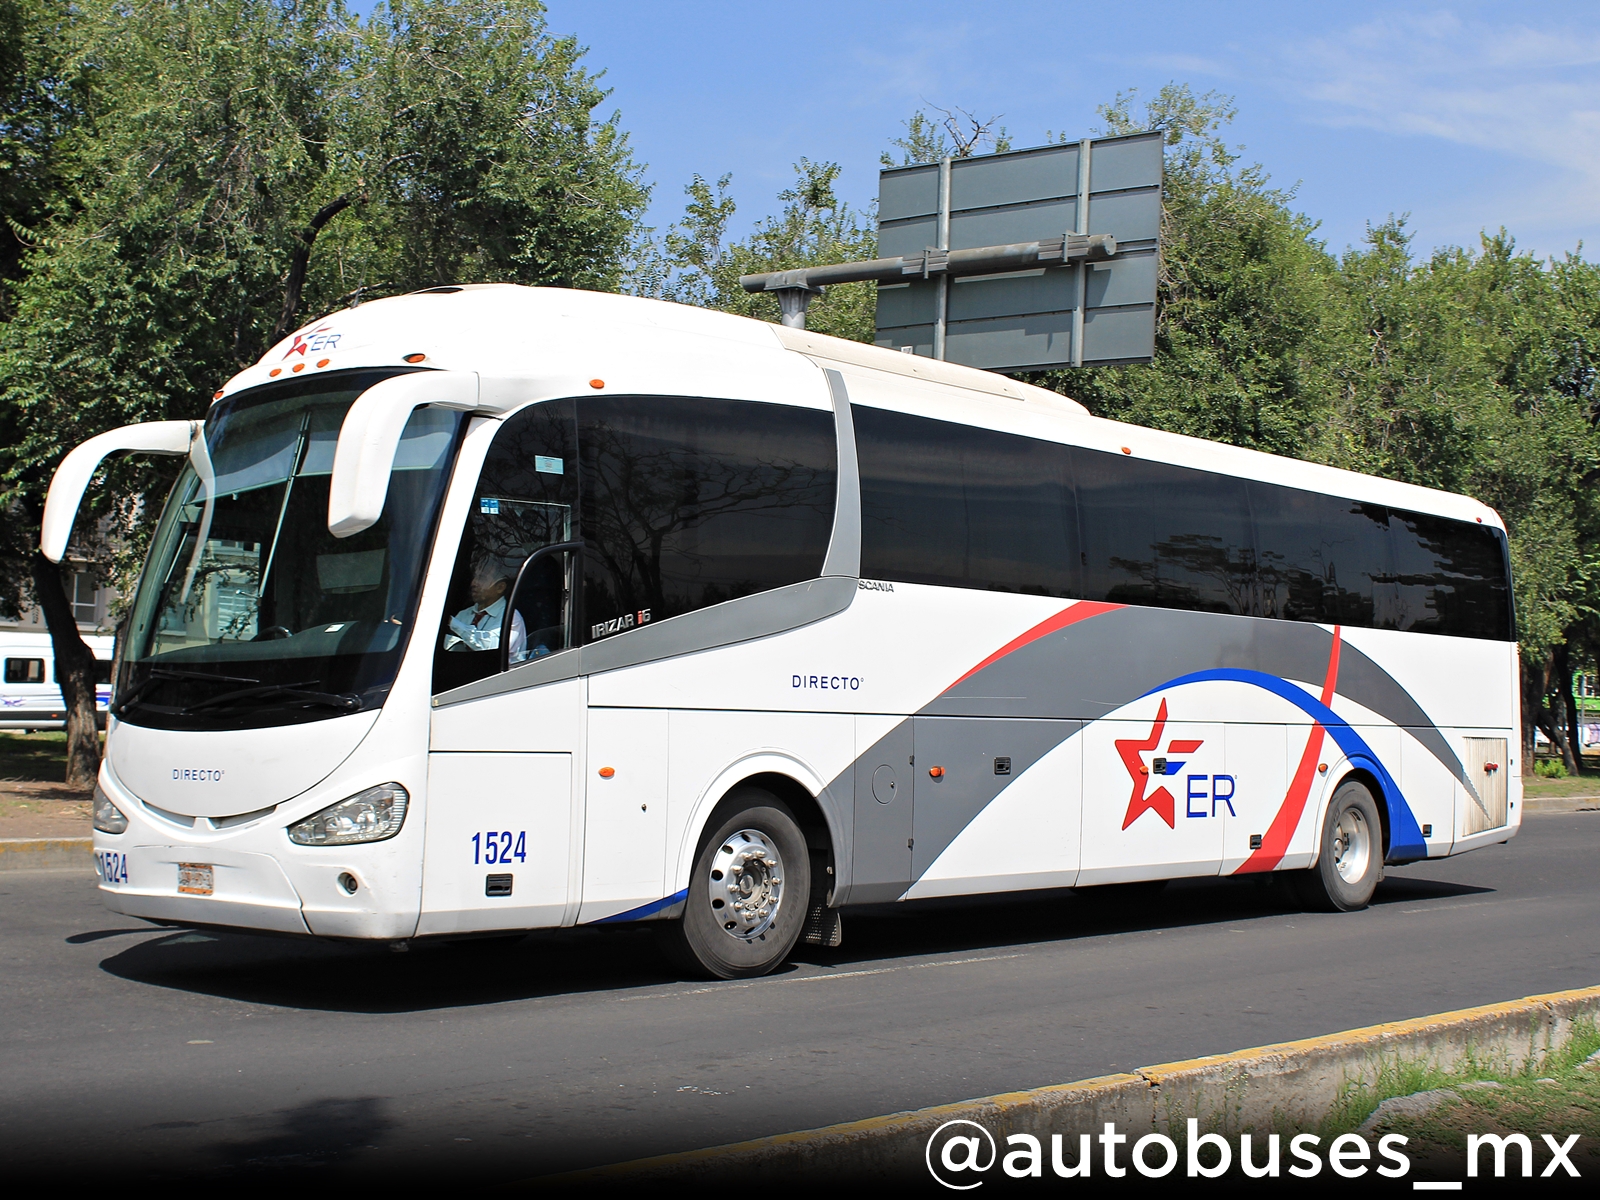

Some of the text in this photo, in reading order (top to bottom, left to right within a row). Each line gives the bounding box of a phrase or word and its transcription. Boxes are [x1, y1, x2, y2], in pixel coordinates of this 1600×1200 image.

[310, 334, 342, 352] ER
[858, 580, 894, 593] SCANIA
[591, 608, 651, 640] IRIZAR i6
[791, 674, 860, 691] DIRECTO
[172, 768, 222, 782] DIRECTO
[1186, 774, 1237, 818] ER
[471, 830, 527, 865] 1524
[100, 851, 128, 884] 1524
